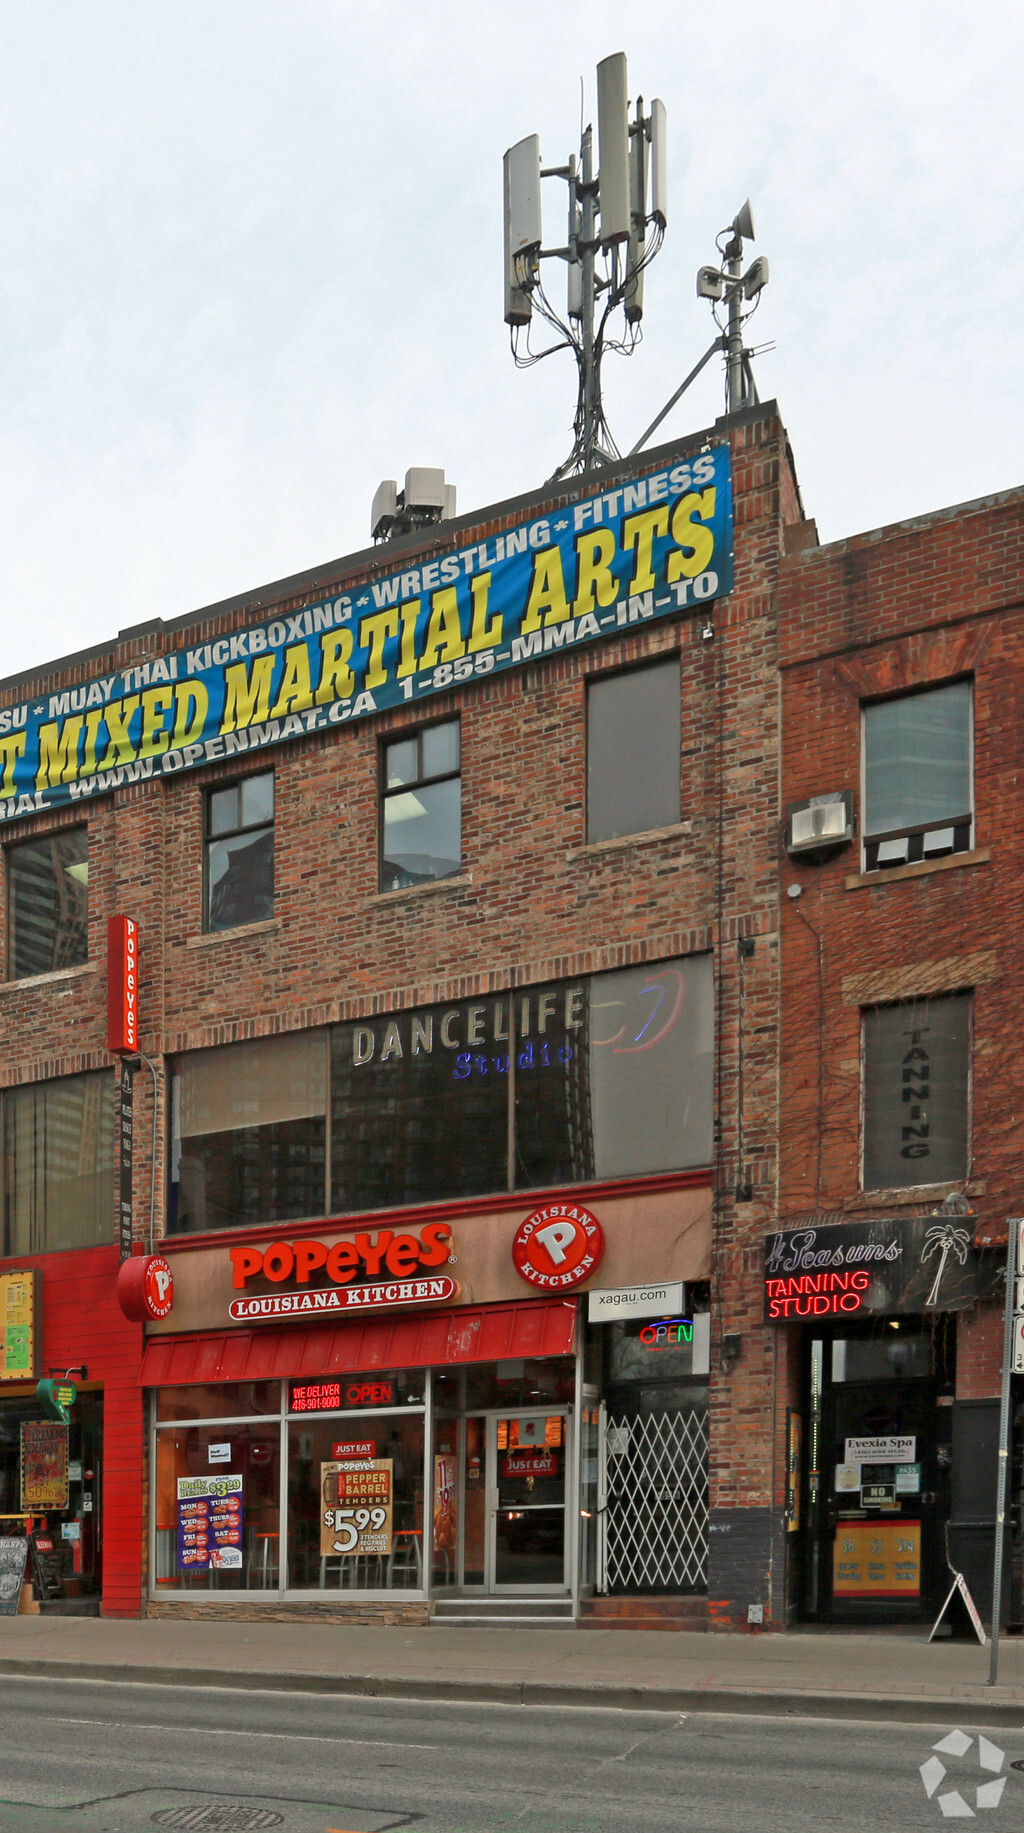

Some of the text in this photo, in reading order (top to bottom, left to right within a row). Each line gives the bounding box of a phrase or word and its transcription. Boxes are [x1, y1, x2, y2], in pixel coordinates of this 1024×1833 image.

[49, 677, 115, 718] MUAY
[121, 656, 178, 694] THAI
[186, 596, 352, 675] KICKBOXING
[371, 520, 551, 607] WRESTLING
[574, 454, 716, 531] FITNESS
[35, 678, 209, 791] MIXED
[218, 569, 504, 737] MARTIAL
[520, 485, 717, 636] ARTS
[68, 690, 378, 800] WWW.OPENMAT.CA
[399, 571, 719, 698] 1-855-MMA-IN-TO
[353, 987, 584, 1067] DANCELIFE
[453, 1042, 574, 1079] Studio
[900, 1027, 931, 1160] TANNING
[518, 1206, 596, 1245] LOUISIANA
[535, 1222, 577, 1265] P
[765, 1233, 785, 1273] 4
[146, 1259, 173, 1282] LOUISIANA
[520, 1254, 594, 1286] KITCHEN
[154, 1271, 170, 1301] P
[765, 1271, 870, 1297] TANNING
[147, 1295, 172, 1316] KITCHEN
[236, 1280, 445, 1316] LOUISIANA KITCHEN
[599, 1289, 667, 1305] xagau.com
[769, 1293, 861, 1318] STUDIO
[639, 1325, 693, 1344] OPEN
[292, 1396, 340, 1410] 416-901-9000
[293, 1384, 392, 1402] WE DELIVER OPEN
[336, 1444, 372, 1453] JUST EAT
[848, 1438, 912, 1448] Evexia Spa
[507, 1459, 552, 1470] JUST EAT
[180, 1479, 207, 1490] Daily
[346, 1473, 386, 1484] PEPPER
[346, 1484, 387, 1495] BARREL
[28, 1486, 54, 1498] 50%
[181, 1488, 208, 1497] DEALS
[871, 1487, 886, 1496] NO
